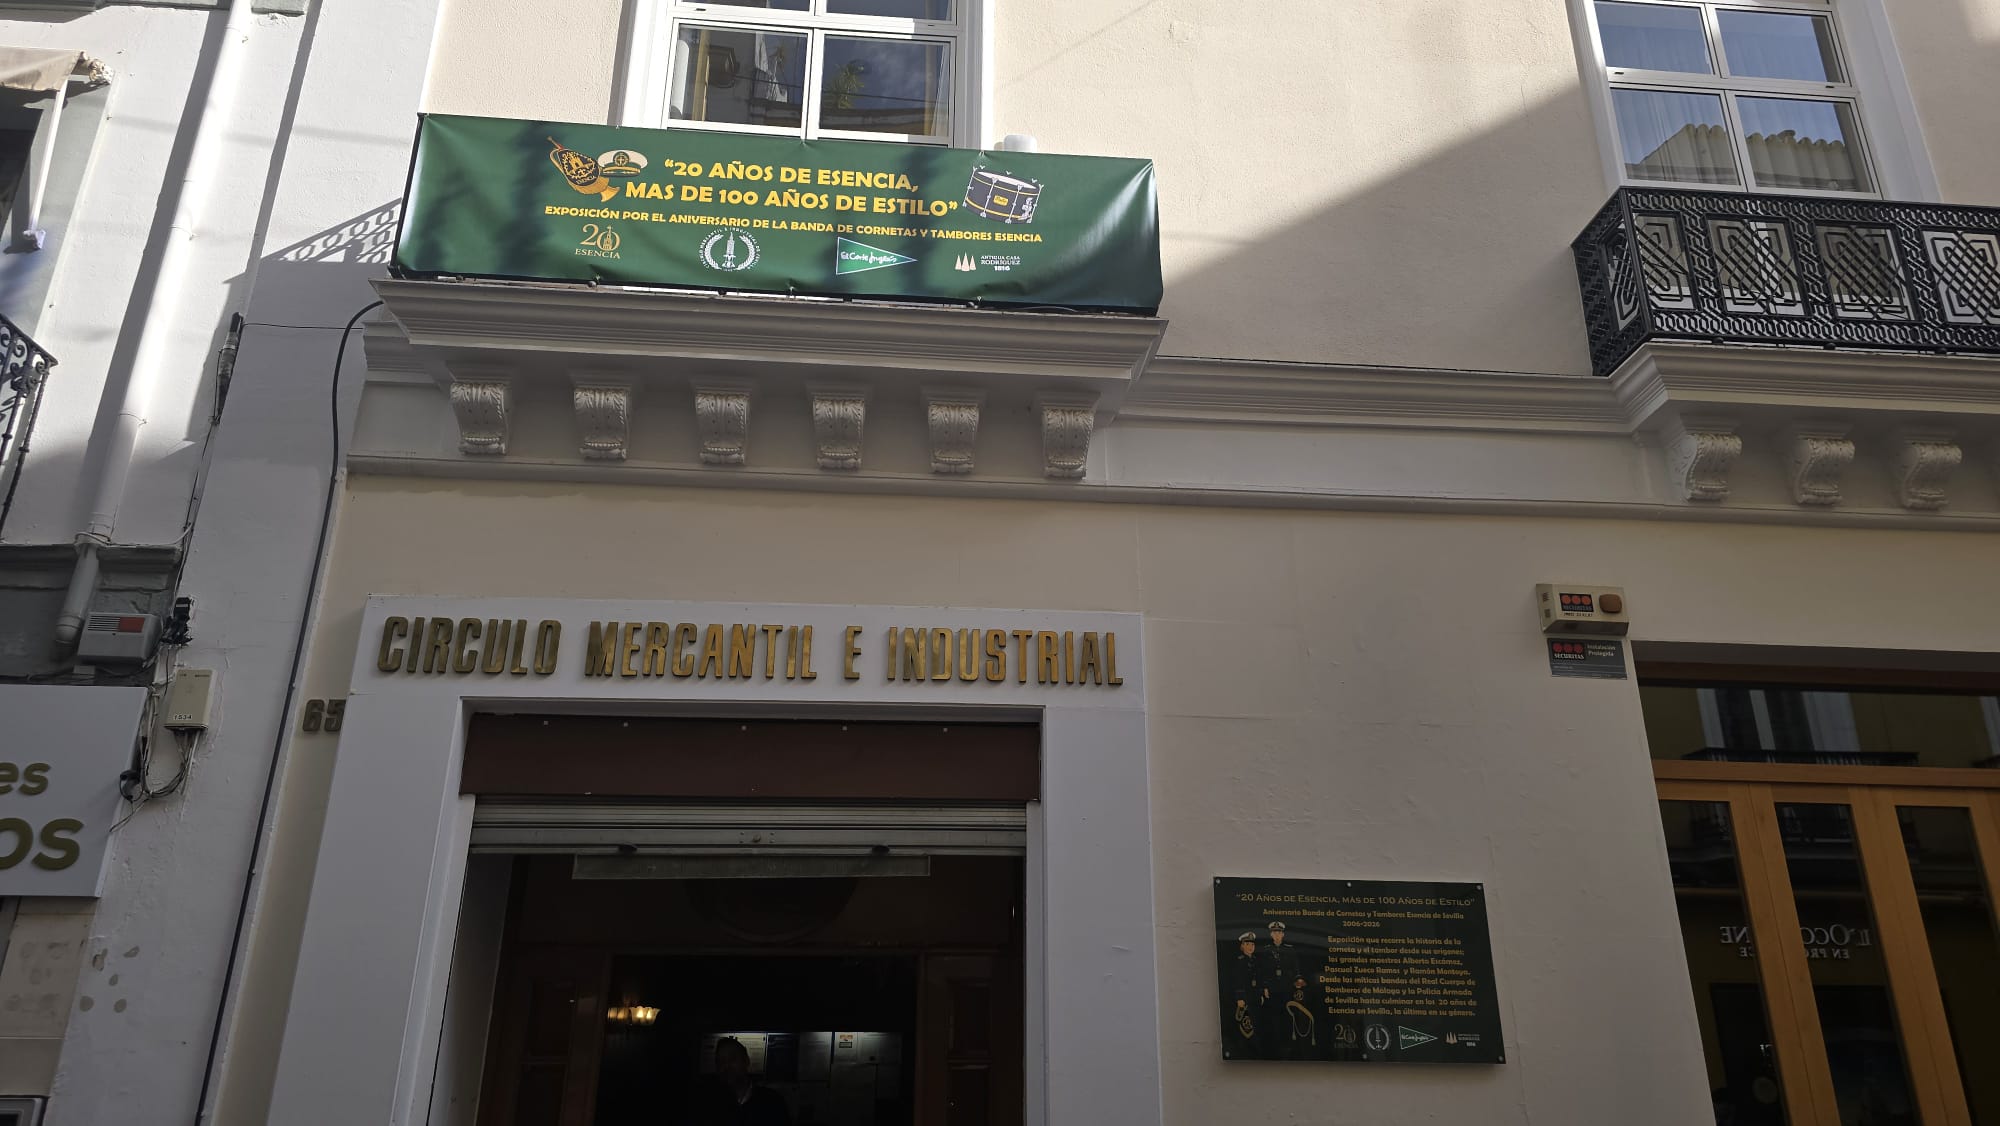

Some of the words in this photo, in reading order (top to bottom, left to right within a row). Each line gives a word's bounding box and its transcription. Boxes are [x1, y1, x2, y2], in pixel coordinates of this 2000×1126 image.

[708, 160, 773, 182] AÑOS
[780, 166, 812, 184] DE
[817, 169, 919, 193] ESENCIA,
[625, 181, 675, 200] MAS
[680, 185, 713, 203] DE
[719, 189, 759, 205] 100
[764, 188, 829, 210] AÑOS
[835, 194, 867, 212] DE
[872, 197, 958, 217] ESTILO”
[544, 205, 620, 220] EXPOSICIÓN
[622, 211, 649, 222] POR
[652, 213, 666, 223] EL
[669, 214, 750, 228] ANIVERSARIO
[752, 219, 769, 229] DE
[772, 220, 788, 230] LA
[790, 221, 834, 233] BANDA
[837, 224, 853, 234] DE
[856, 225, 917, 237] CORNETAS
[919, 228, 928, 238] Y
[930, 229, 992, 241] TAMBORES
[994, 232, 1043, 243] ESENCIA
[575, 248, 620, 259] ESENCIA
[376, 616, 562, 675] CIRCULO
[584, 620, 817, 681] MERCANTIL
[843, 625, 863, 681] E
[887, 626, 1124, 686] INDUSTRIAL
[302, 699, 346, 732] 65
[1378, 896, 1395, 905] 100
[1302, 909, 1324, 917] Banda
[1365, 937, 1379, 945] que
[1415, 937, 1442, 945] historia
[1324, 965, 1352, 973] Pascual
[1319, 975, 1341, 983] Desde
[1421, 977, 1438, 985] Real
[1325, 985, 1360, 993] Bomberos
[1362, 986, 1371, 994] de
